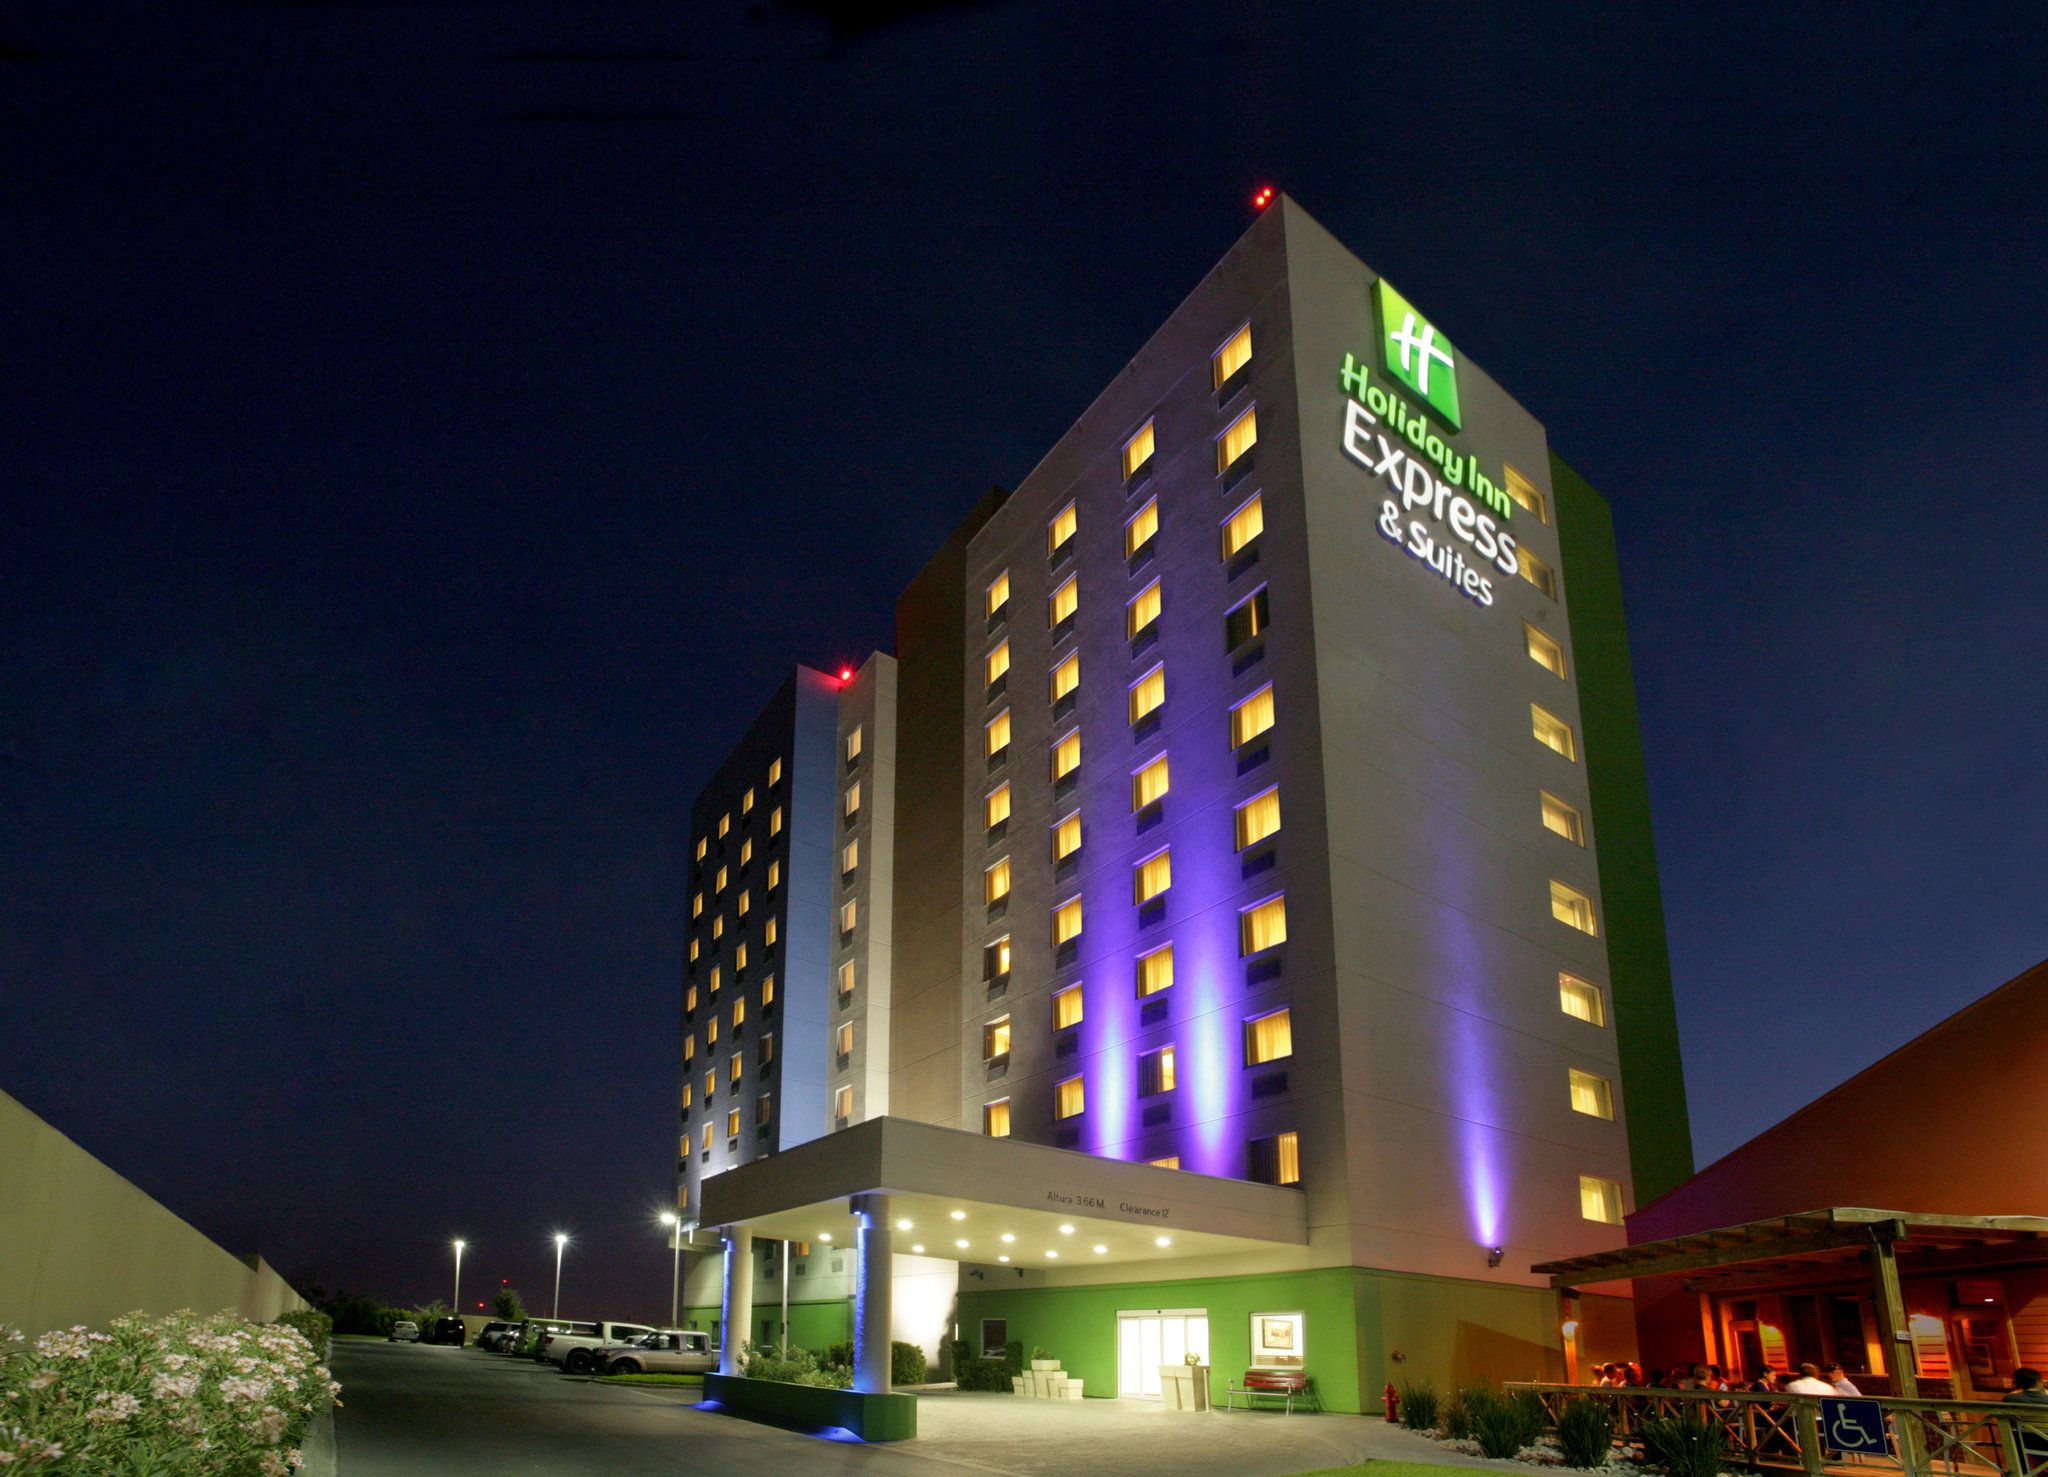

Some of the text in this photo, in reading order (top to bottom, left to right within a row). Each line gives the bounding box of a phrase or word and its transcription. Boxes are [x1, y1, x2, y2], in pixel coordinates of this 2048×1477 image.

[1341, 352, 1511, 521] Holiday Inn
[1343, 398, 1519, 575] Express
[1379, 500, 1493, 606] & Suites
[1047, 1191, 1073, 1205] Altura
[1120, 1202, 1161, 1217] Clearance
